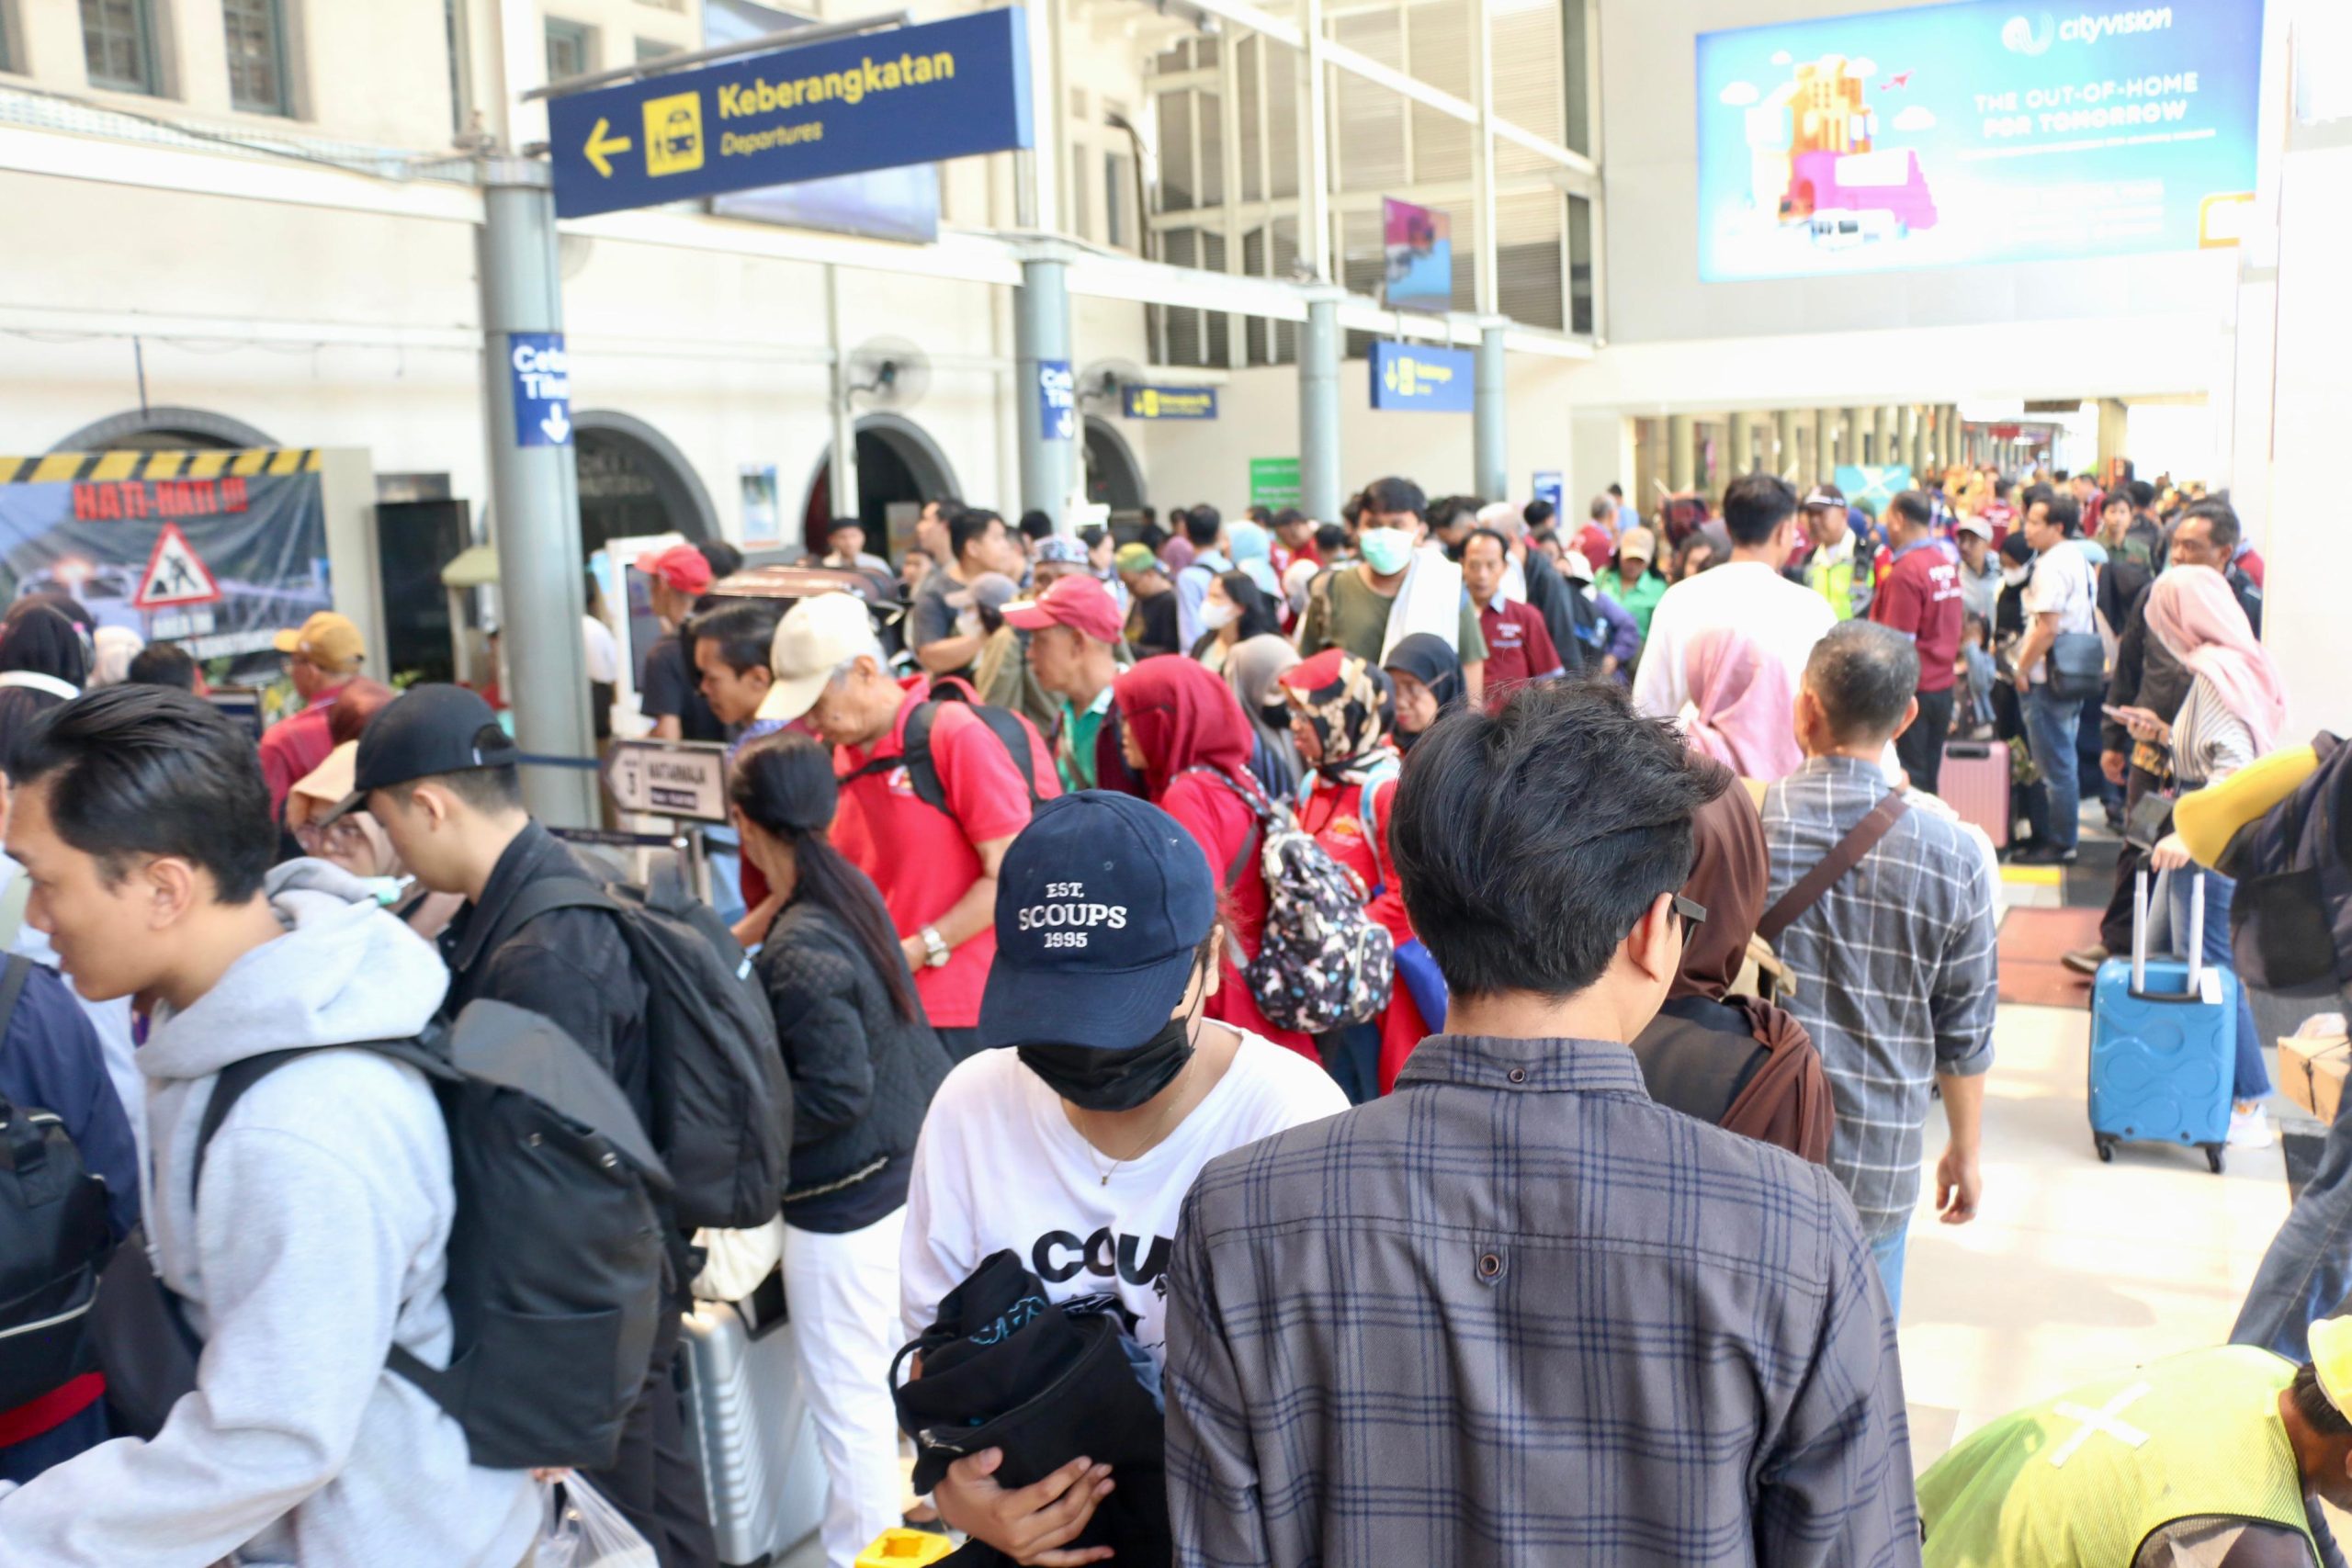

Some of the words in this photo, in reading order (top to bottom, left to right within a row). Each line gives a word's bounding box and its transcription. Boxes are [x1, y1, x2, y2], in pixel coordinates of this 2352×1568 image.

[2059, 7, 2173, 44] cityvision
[718, 52, 955, 118] Keberangkatan
[1973, 91, 2018, 114] THE
[2025, 73, 2199, 108] OUT-OF-HOME
[720, 121, 824, 156] Departures
[1983, 117, 2031, 139] FOR
[2039, 100, 2188, 132] TOMORROW
[74, 479, 218, 521] HATI-HATI
[1019, 903, 1127, 931] SCOUPS
[1044, 931, 1088, 948] 1995
